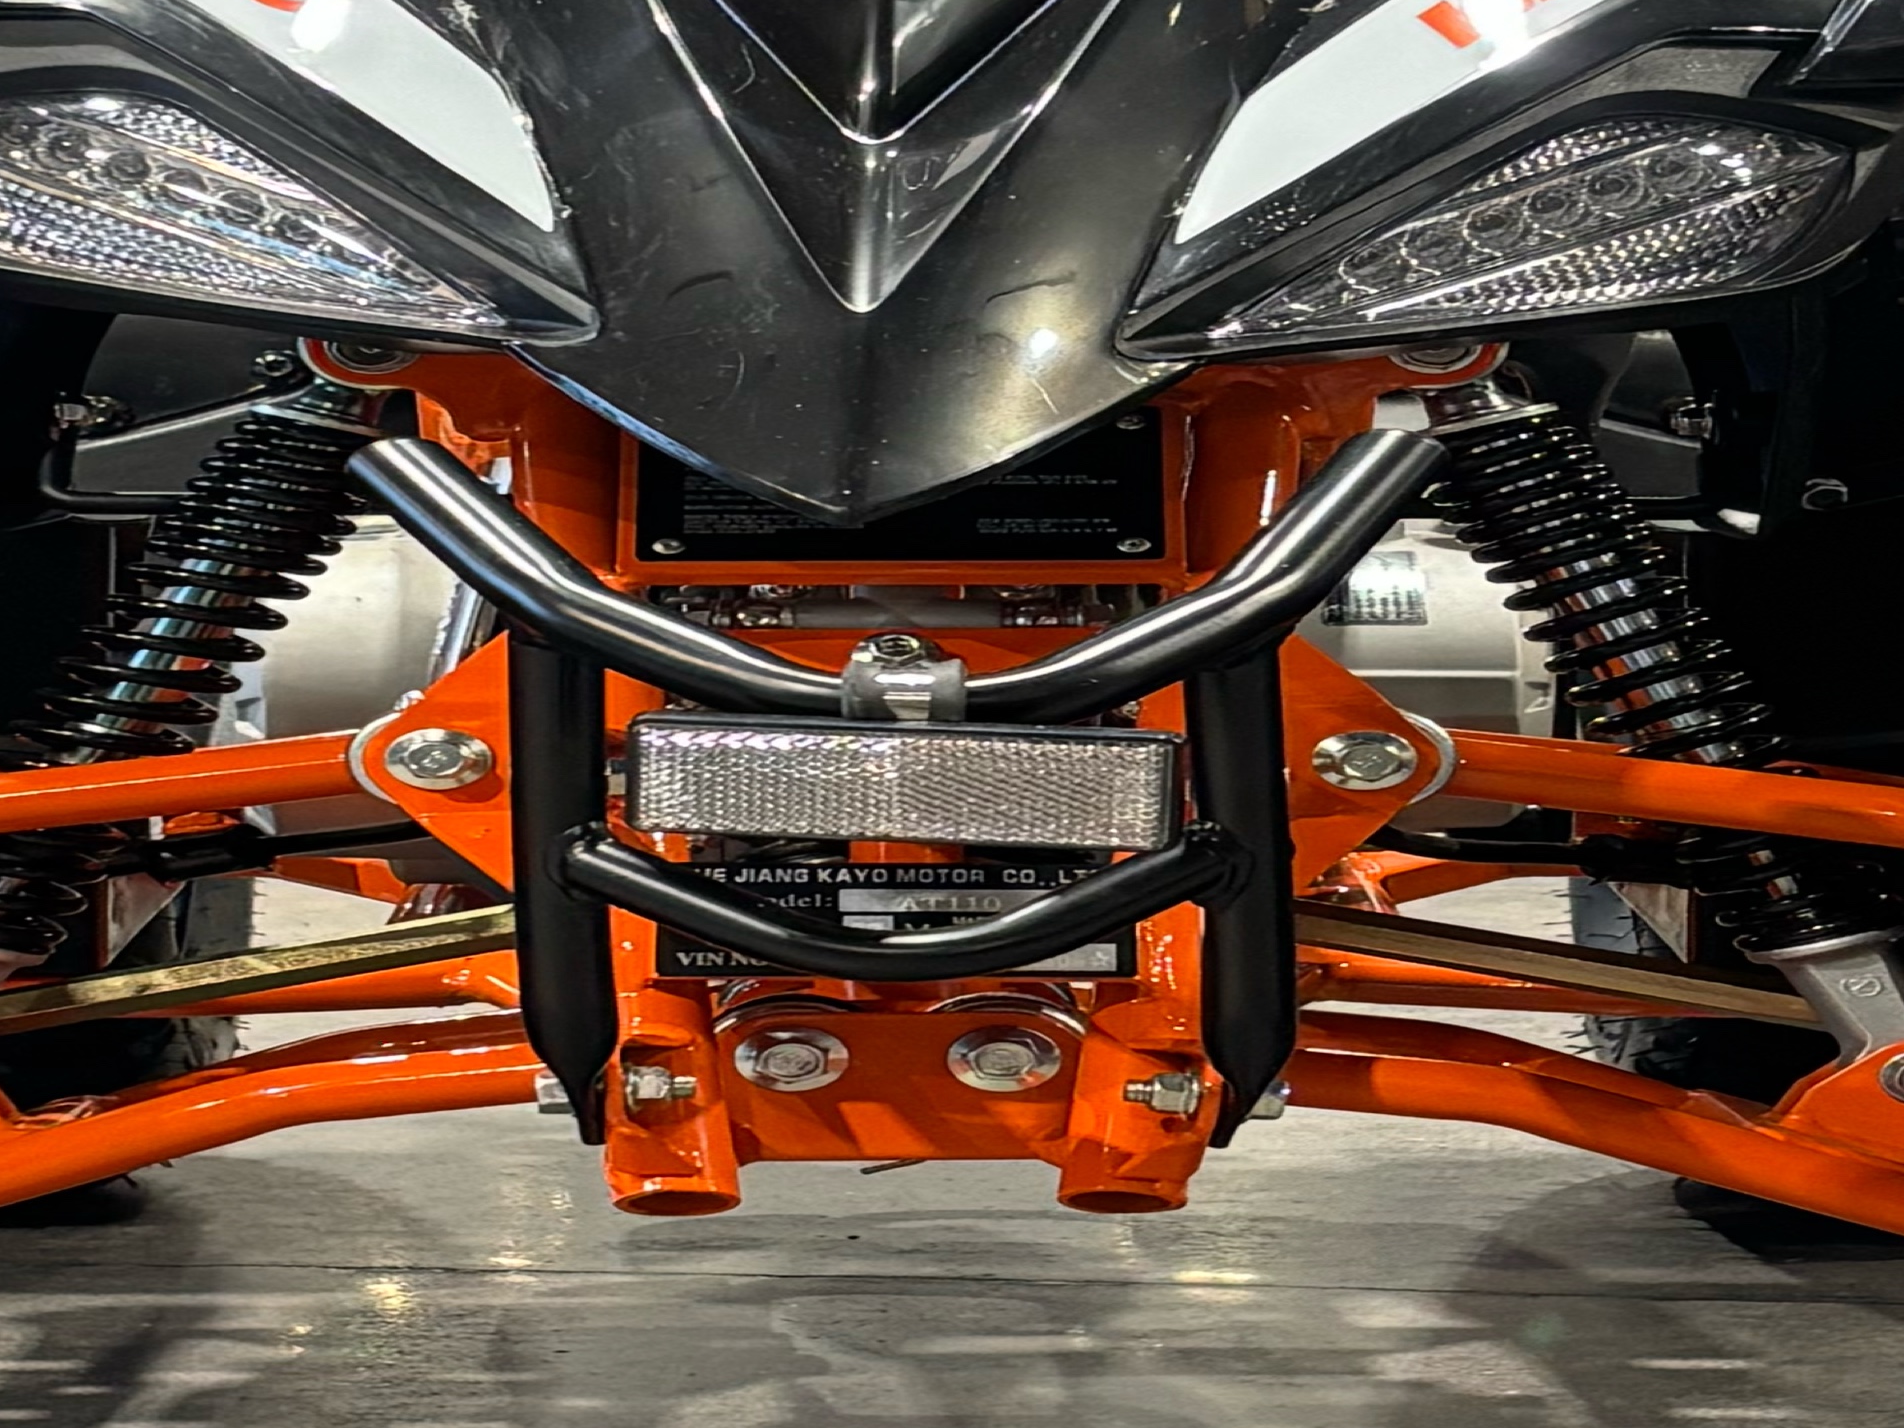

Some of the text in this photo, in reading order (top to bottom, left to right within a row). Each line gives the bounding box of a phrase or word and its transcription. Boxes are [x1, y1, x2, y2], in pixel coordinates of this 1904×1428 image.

[734, 868, 809, 883] JIANG
[817, 868, 888, 883] KAYO
[896, 868, 985, 883] MOTOR
[899, 897, 1002, 911] AT110
[675, 952, 725, 967] VIN
